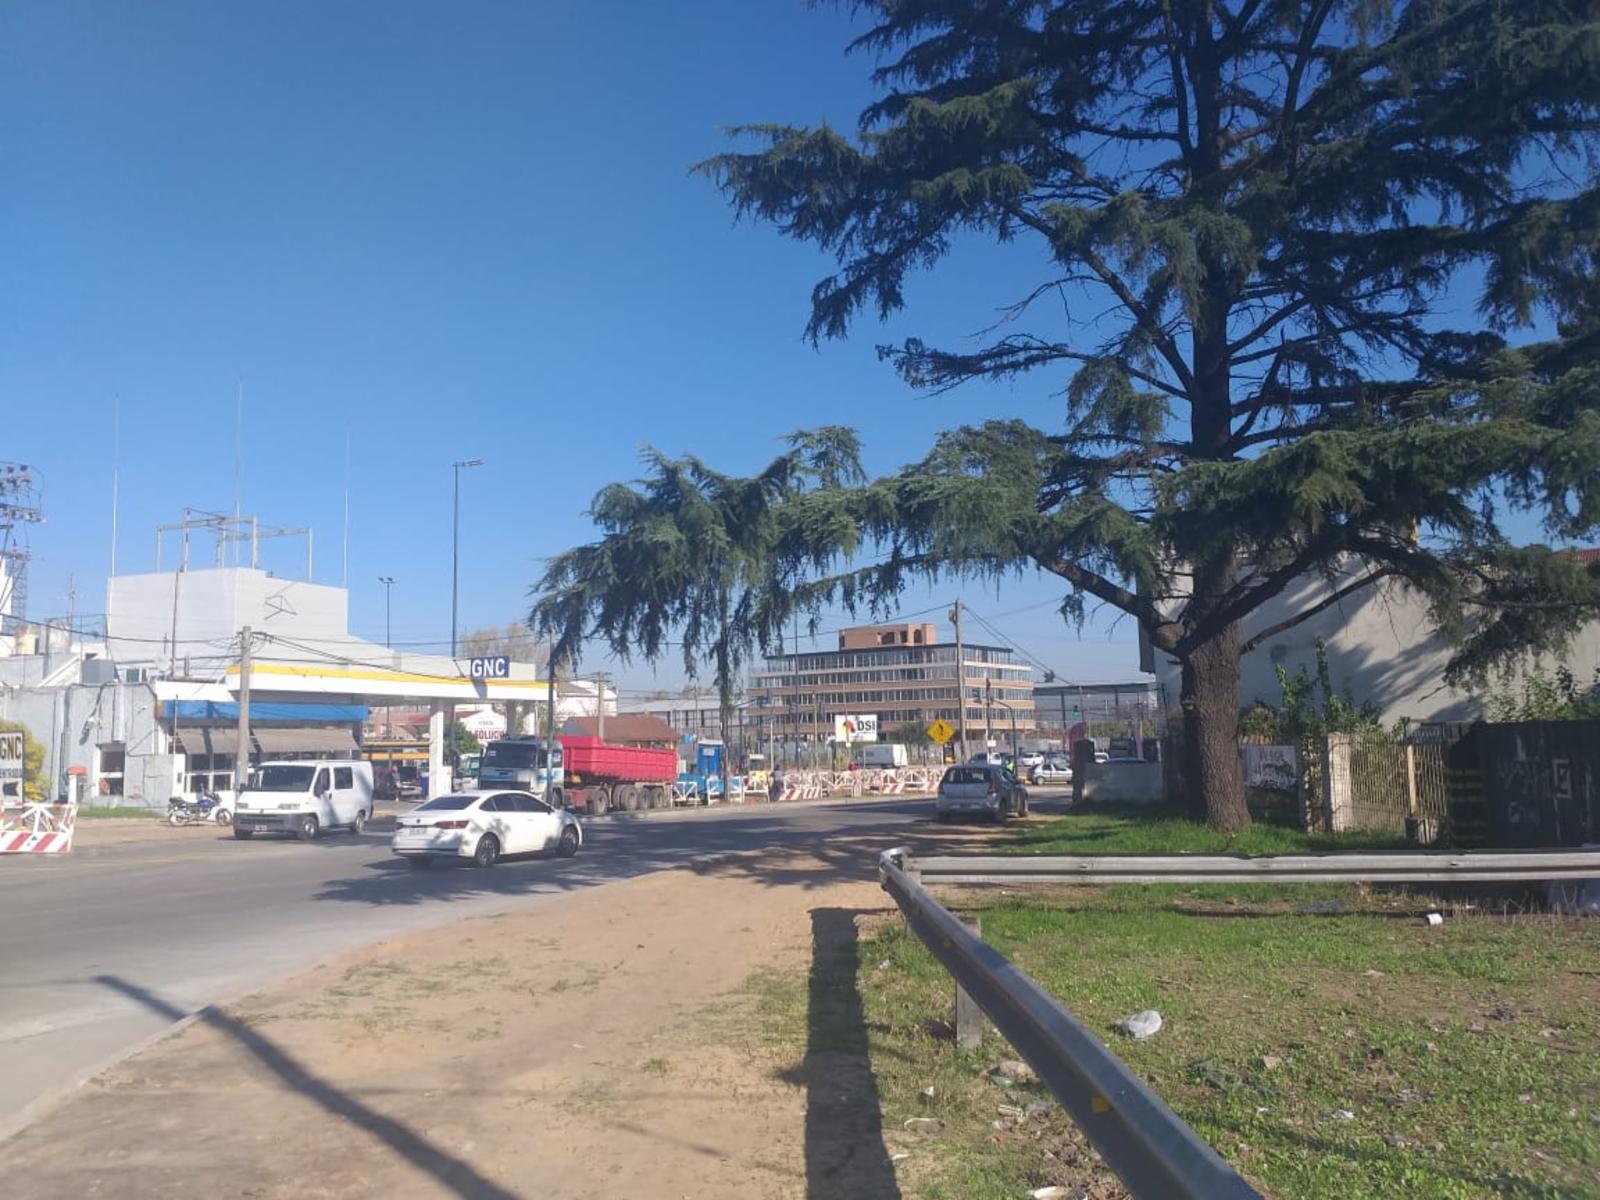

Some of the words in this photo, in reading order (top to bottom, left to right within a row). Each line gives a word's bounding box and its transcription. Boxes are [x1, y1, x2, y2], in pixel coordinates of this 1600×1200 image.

[471, 657, 506, 677] GNC
[857, 720, 876, 731] DSI
[0, 736, 21, 760] GNC
